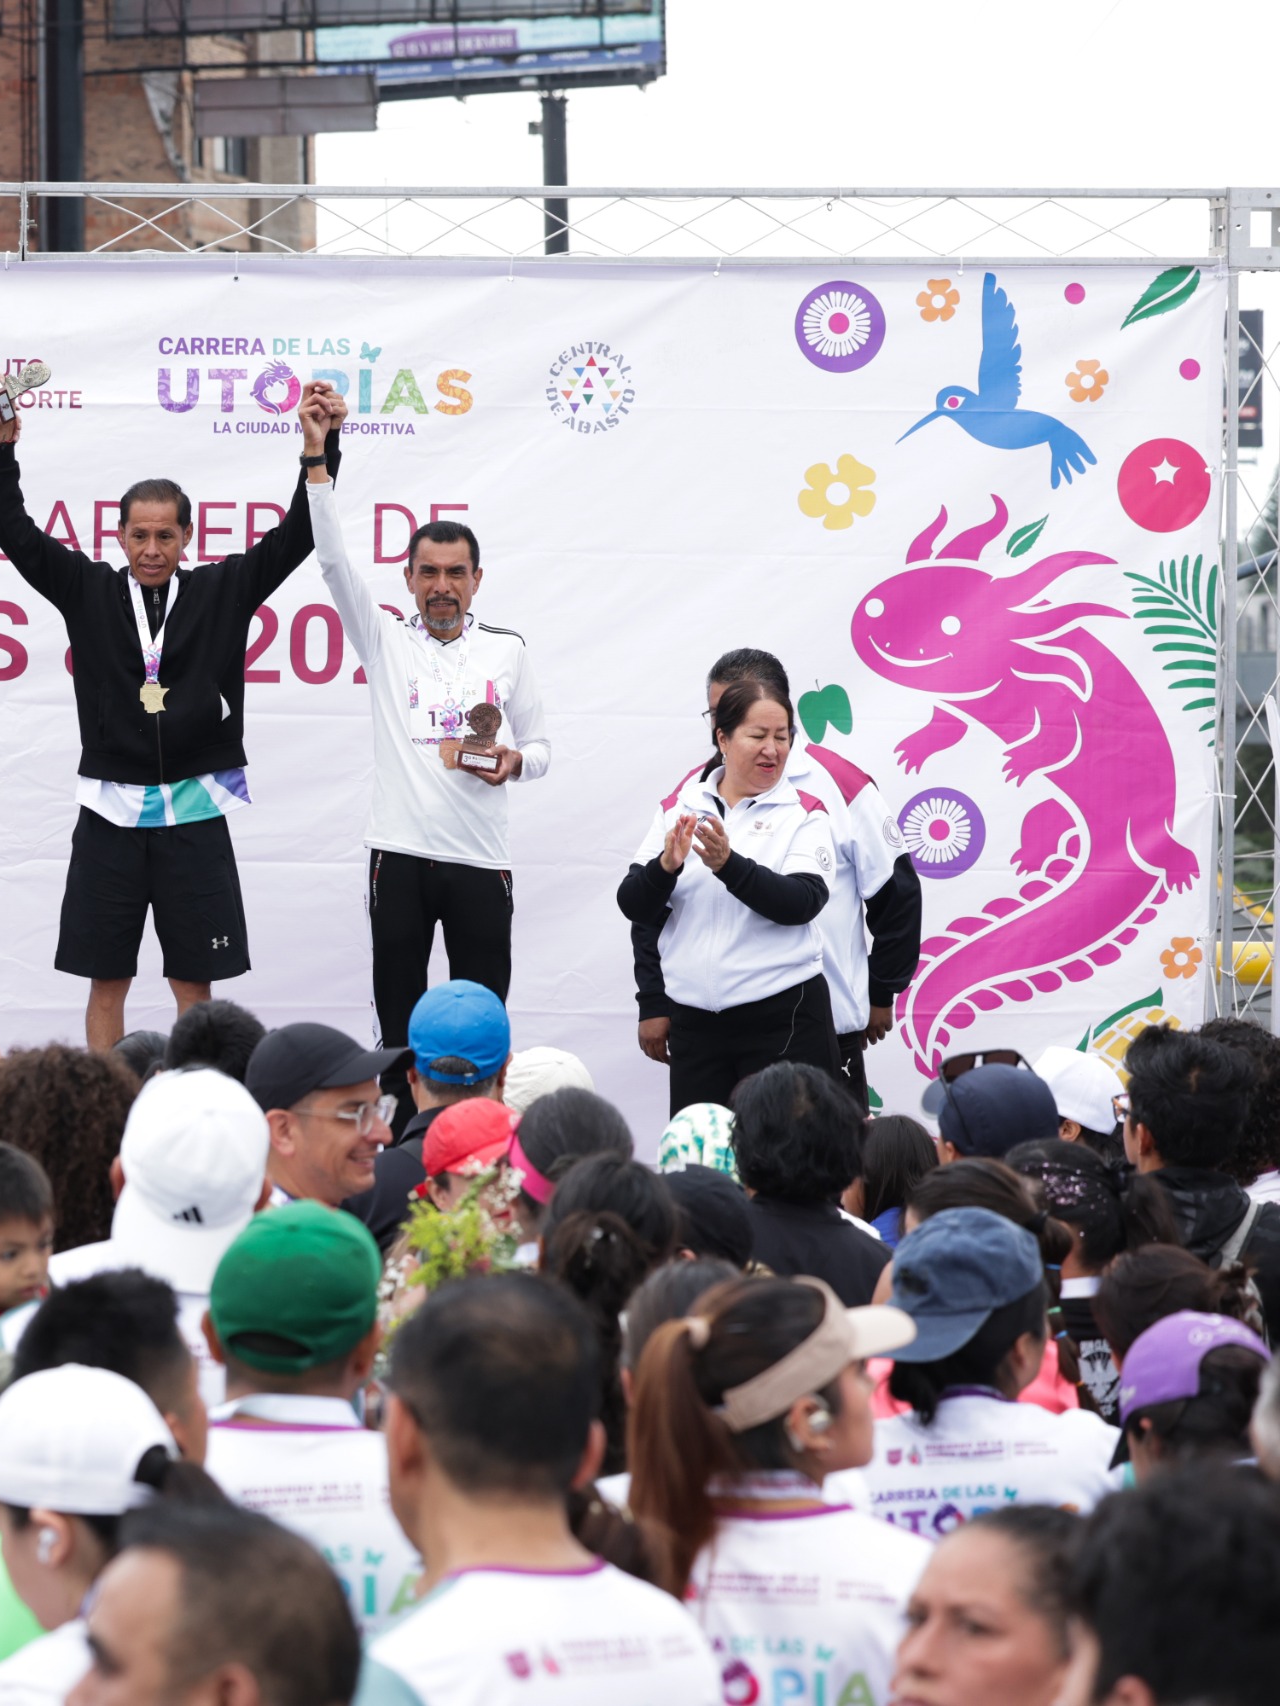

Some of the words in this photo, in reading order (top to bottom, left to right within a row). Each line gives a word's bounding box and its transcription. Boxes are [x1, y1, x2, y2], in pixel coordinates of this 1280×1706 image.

[158, 337, 265, 355] CARRERA
[273, 338, 300, 355] DE
[307, 338, 350, 356] LAS
[549, 341, 631, 380] CENTRAL
[213, 422, 231, 433] LA
[236, 422, 290, 434] CIUDAD
[342, 423, 415, 435] EPORTIVA
